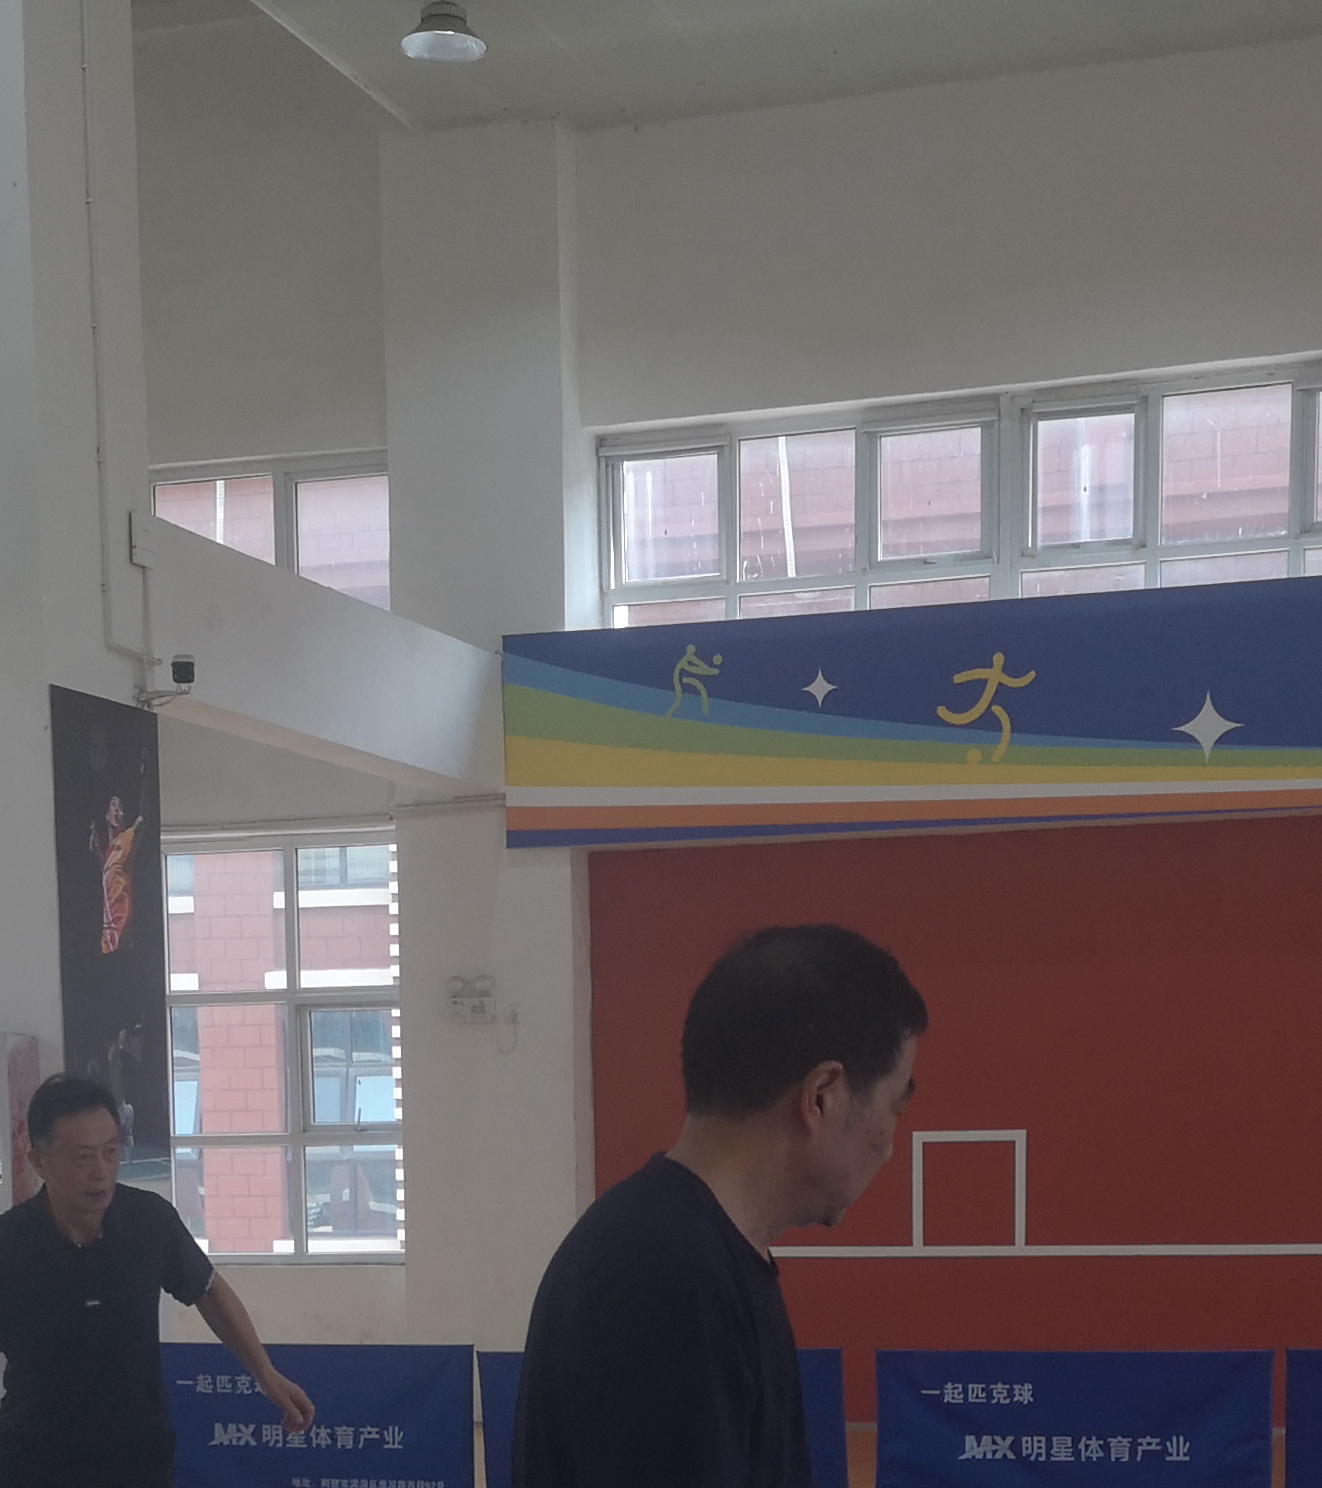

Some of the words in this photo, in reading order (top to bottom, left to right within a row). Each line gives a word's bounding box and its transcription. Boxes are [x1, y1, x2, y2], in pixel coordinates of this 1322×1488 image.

[920, 1382, 1034, 1405] 一起匹克球
[209, 1422, 257, 1446] MX
[262, 1425, 404, 1449] 明星体育产业
[958, 1434, 1016, 1460] MX
[1021, 1435, 1191, 1462] 明星体育产业
